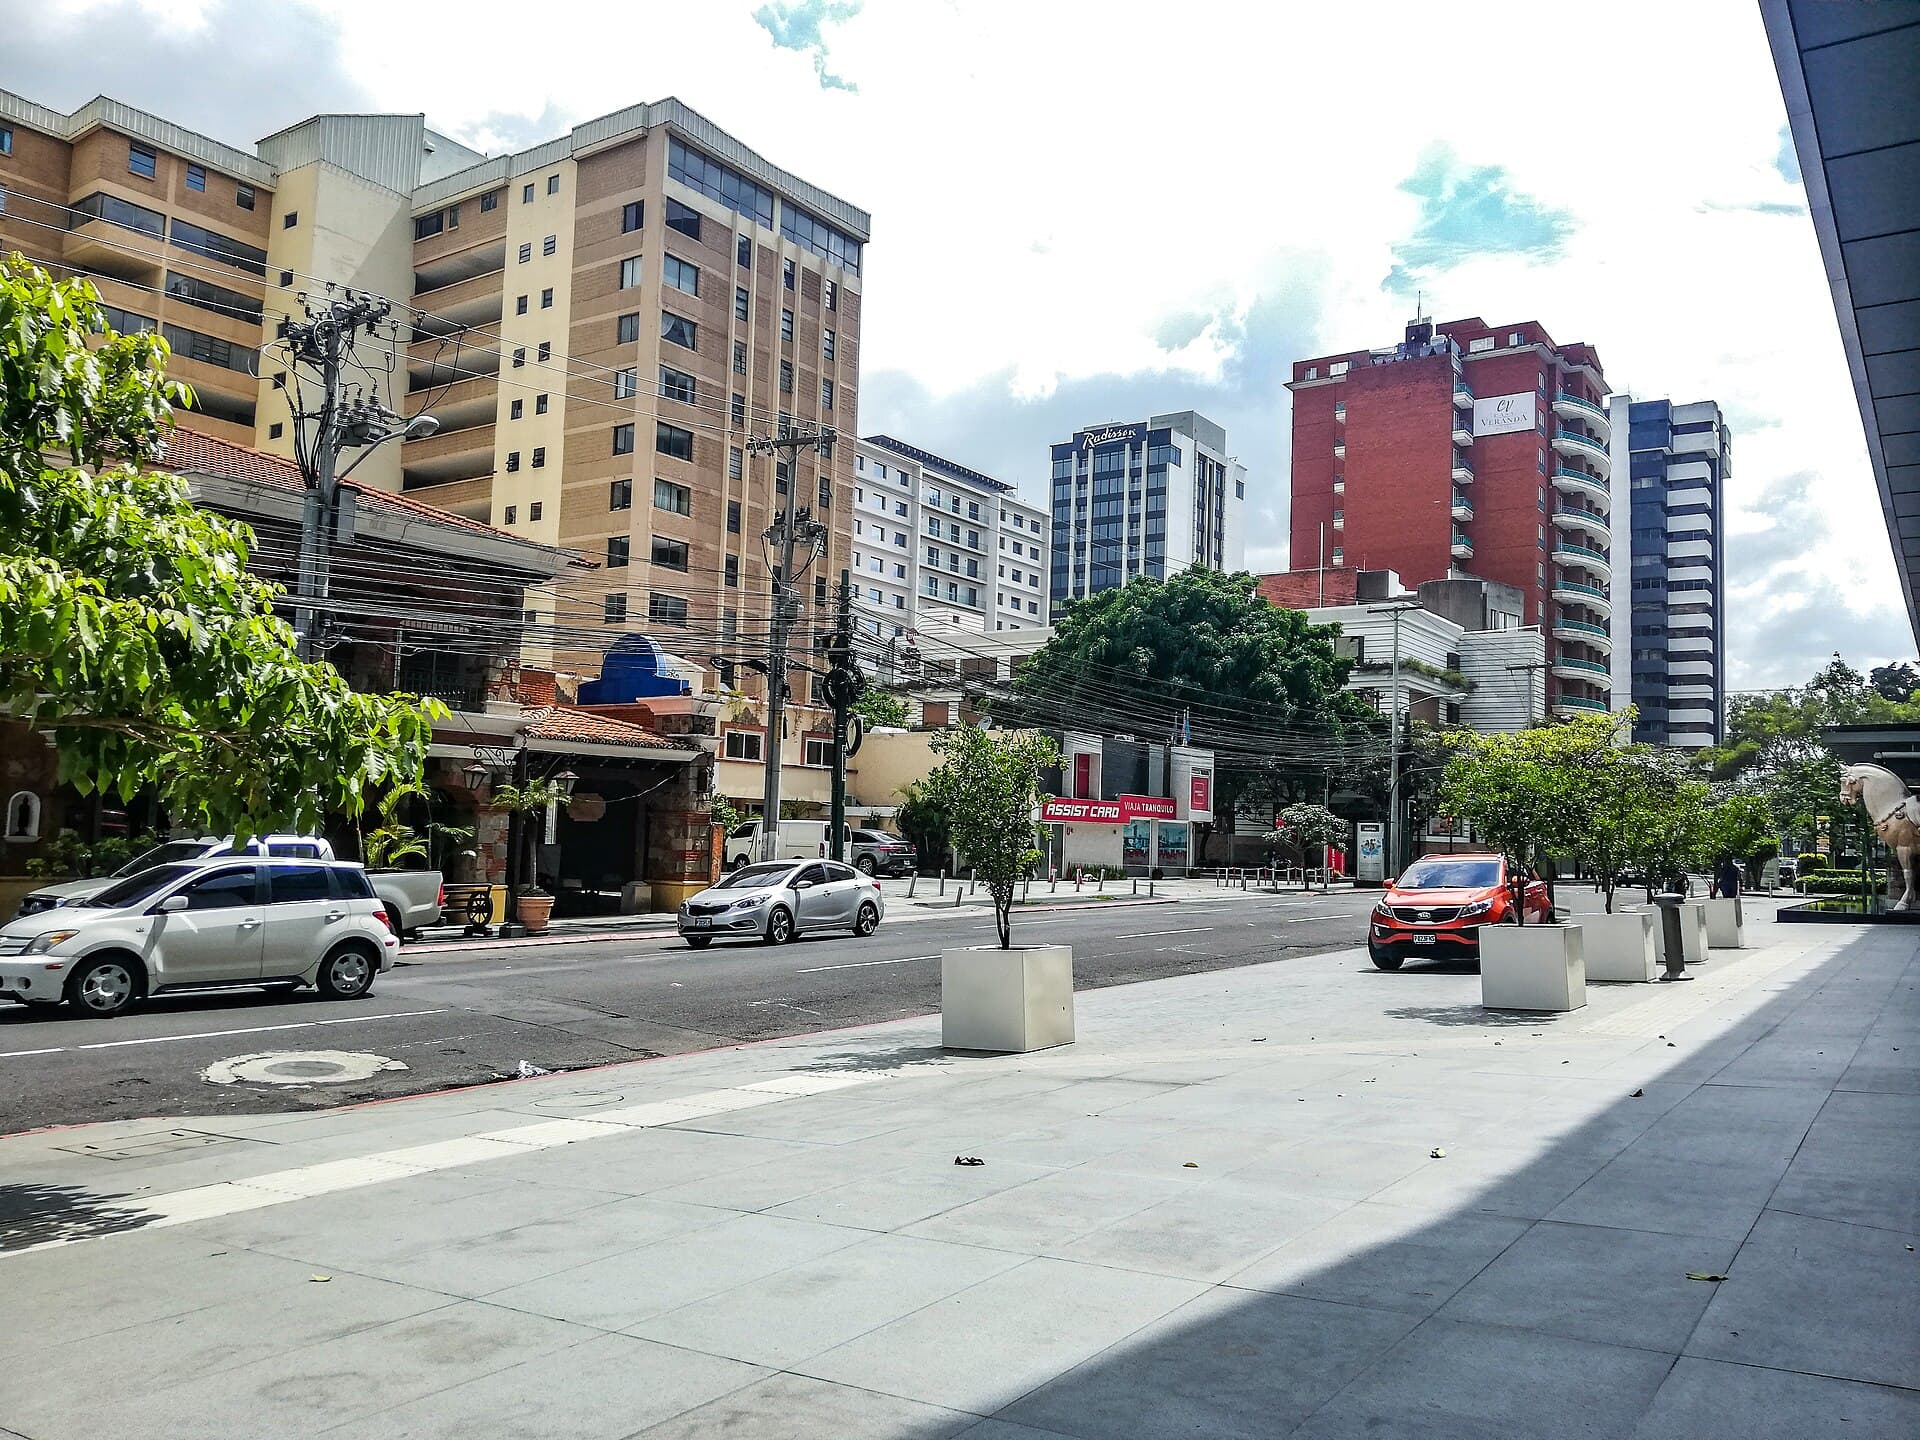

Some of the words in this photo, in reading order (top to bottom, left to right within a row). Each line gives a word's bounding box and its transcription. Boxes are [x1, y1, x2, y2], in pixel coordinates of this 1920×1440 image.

[1481, 414, 1528, 426] VERANDA
[1082, 427, 1136, 450] Radisson
[1046, 803, 1089, 817] ASSIST
[1090, 805, 1119, 819] CARD
[1124, 801, 1141, 811] VIAJA
[1141, 803, 1174, 814] TRANQUILO
